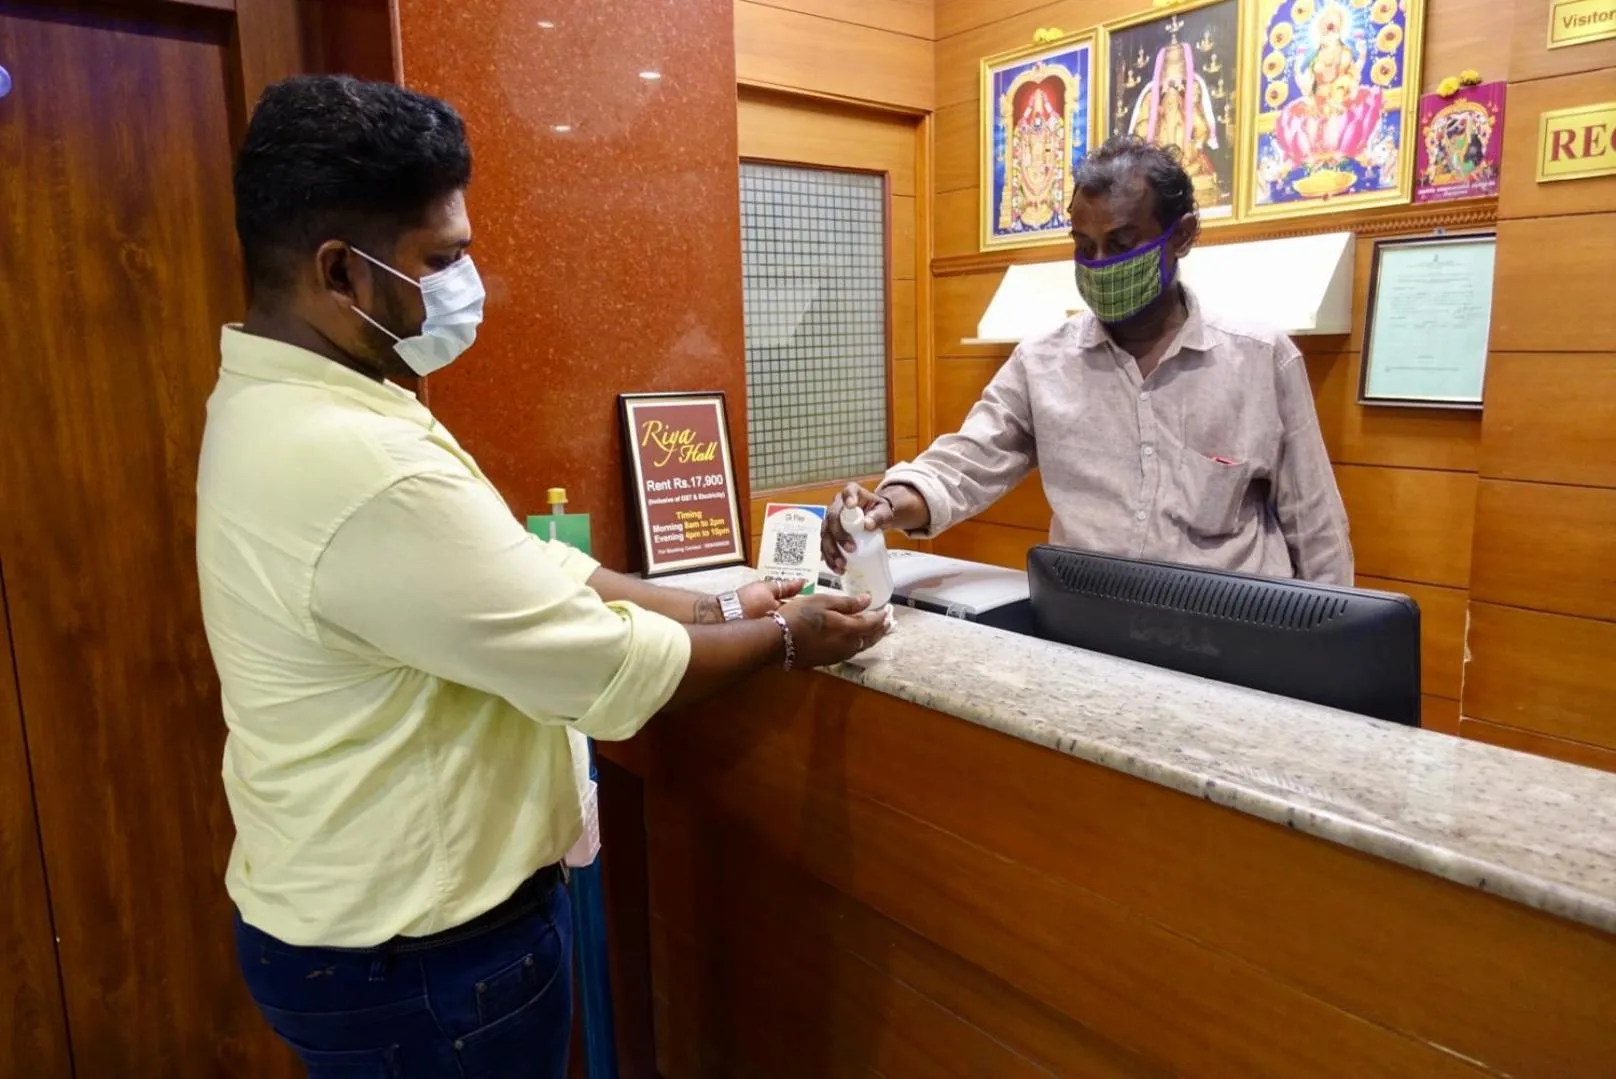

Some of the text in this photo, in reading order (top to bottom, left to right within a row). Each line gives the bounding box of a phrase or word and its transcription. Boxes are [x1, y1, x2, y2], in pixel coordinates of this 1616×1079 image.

[1549, 123, 1616, 162] RE
[642, 420, 697, 467] Riya
[678, 441, 718, 463] Hall
[646, 479, 672, 491] Rent
[676, 510, 703, 519] Timing
[652, 523, 684, 533] Morning
[700, 519, 709, 527] to
[710, 518, 725, 526] 2pm
[654, 533, 685, 543] Evening
[701, 529, 710, 537] to
